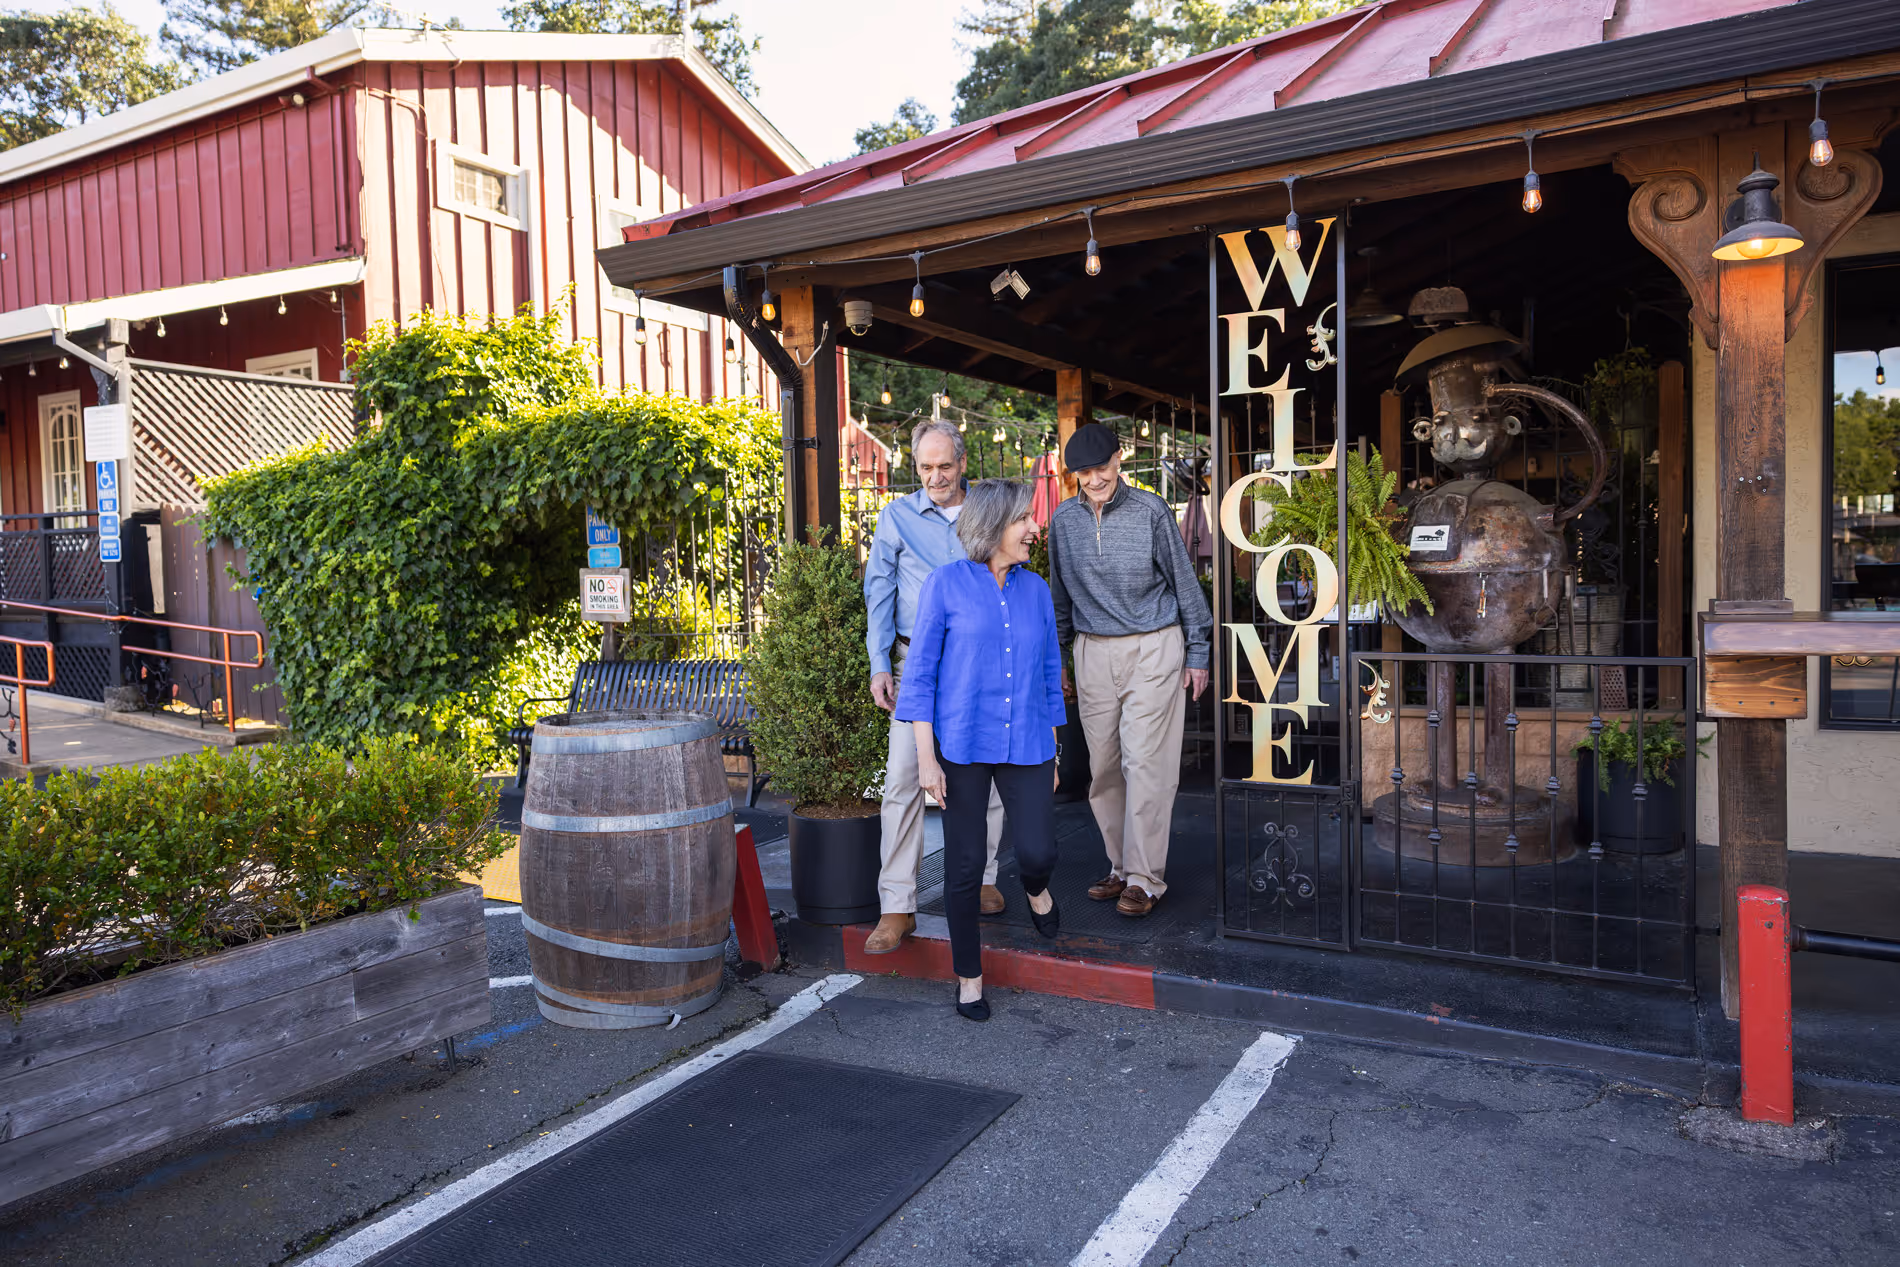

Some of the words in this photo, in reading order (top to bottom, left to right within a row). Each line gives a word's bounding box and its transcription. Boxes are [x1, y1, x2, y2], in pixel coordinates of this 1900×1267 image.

[1217, 217, 1339, 785] WELCOME
[595, 529, 611, 542] ONLY
[590, 579, 604, 592] NO
[590, 595, 618, 603] SMOKING
